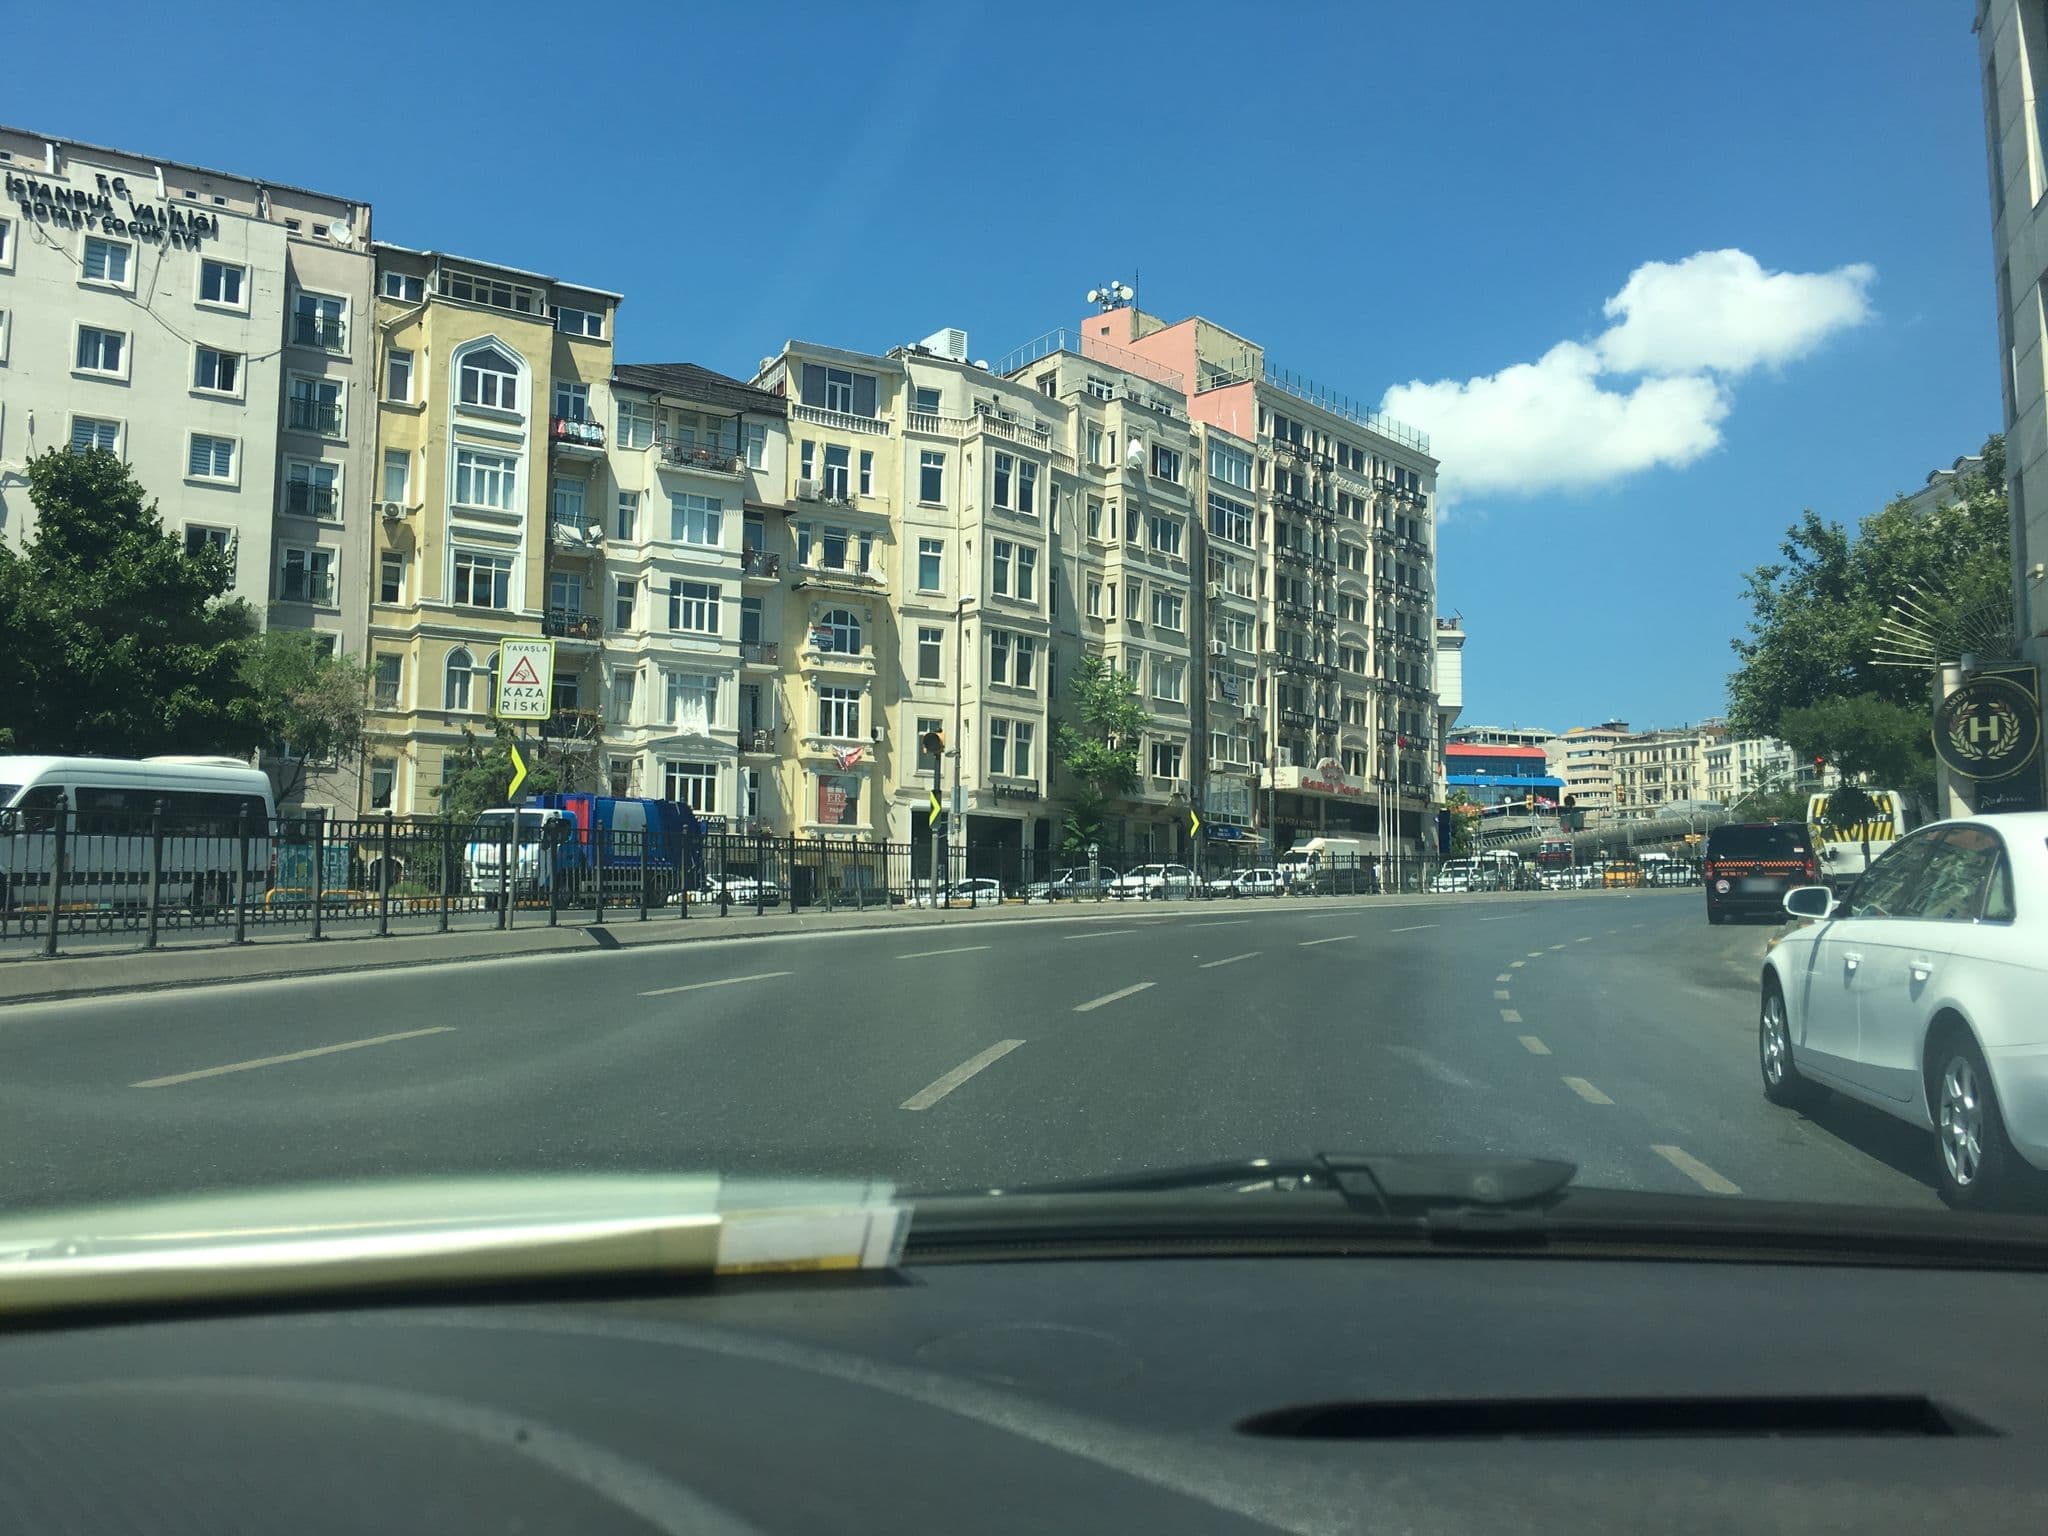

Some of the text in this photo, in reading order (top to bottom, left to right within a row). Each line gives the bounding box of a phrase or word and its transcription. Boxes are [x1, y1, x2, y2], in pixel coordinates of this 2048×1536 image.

[6, 171, 114, 215] İSTANBUL
[21, 199, 96, 230] ROTARY
[506, 645, 548, 653] YAVAŞLA
[503, 687, 544, 698] KAZA
[502, 699, 546, 712] RİSKİ
[1969, 715, 1999, 743] H
